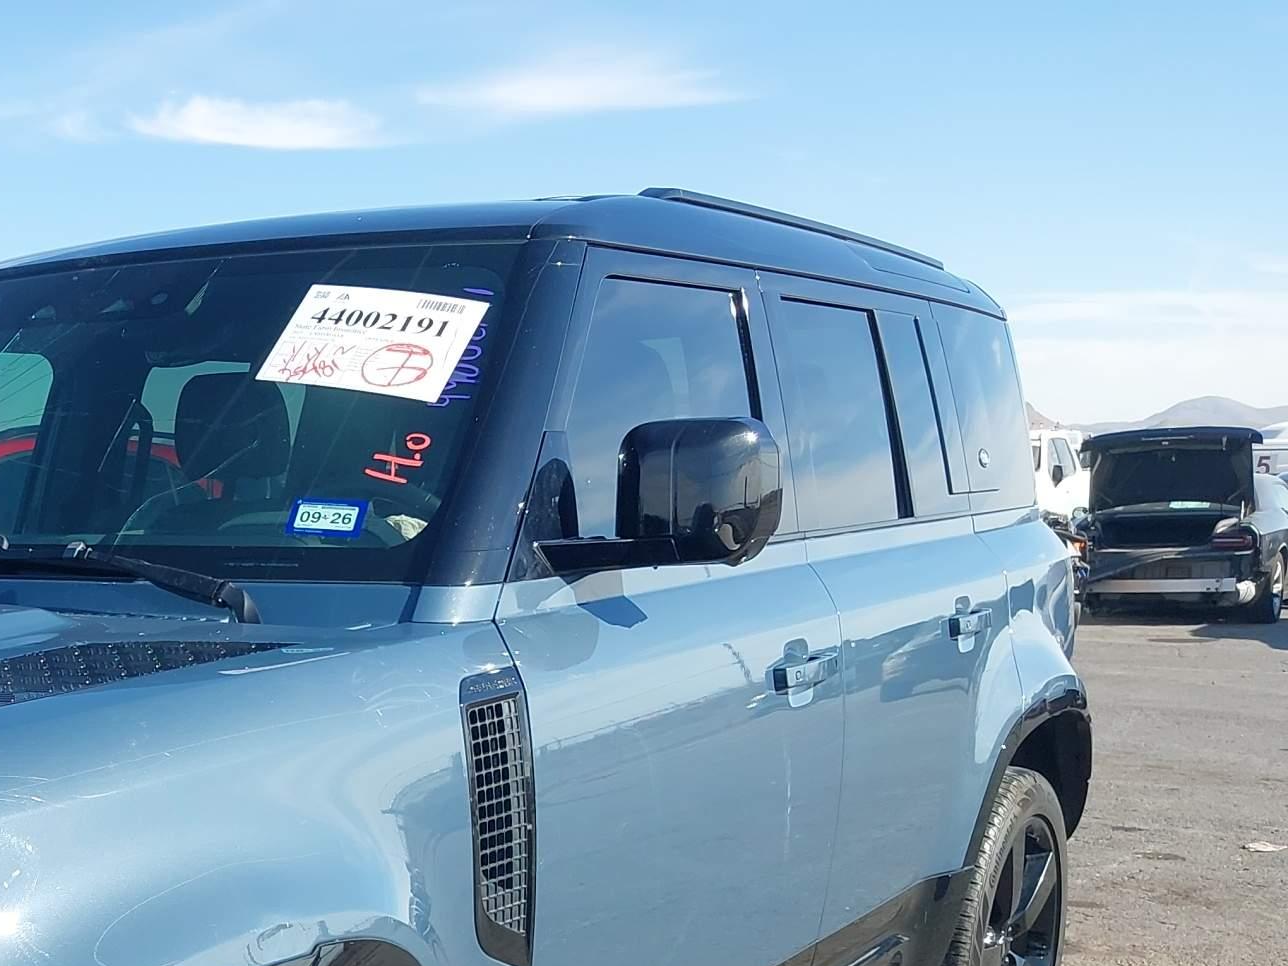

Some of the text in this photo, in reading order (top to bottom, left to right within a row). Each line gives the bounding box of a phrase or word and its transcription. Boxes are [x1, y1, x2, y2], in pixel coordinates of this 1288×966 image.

[311, 306, 450, 338] 44002191
[1256, 455, 1271, 474] 5
[300, 511, 353, 525] 09 26
